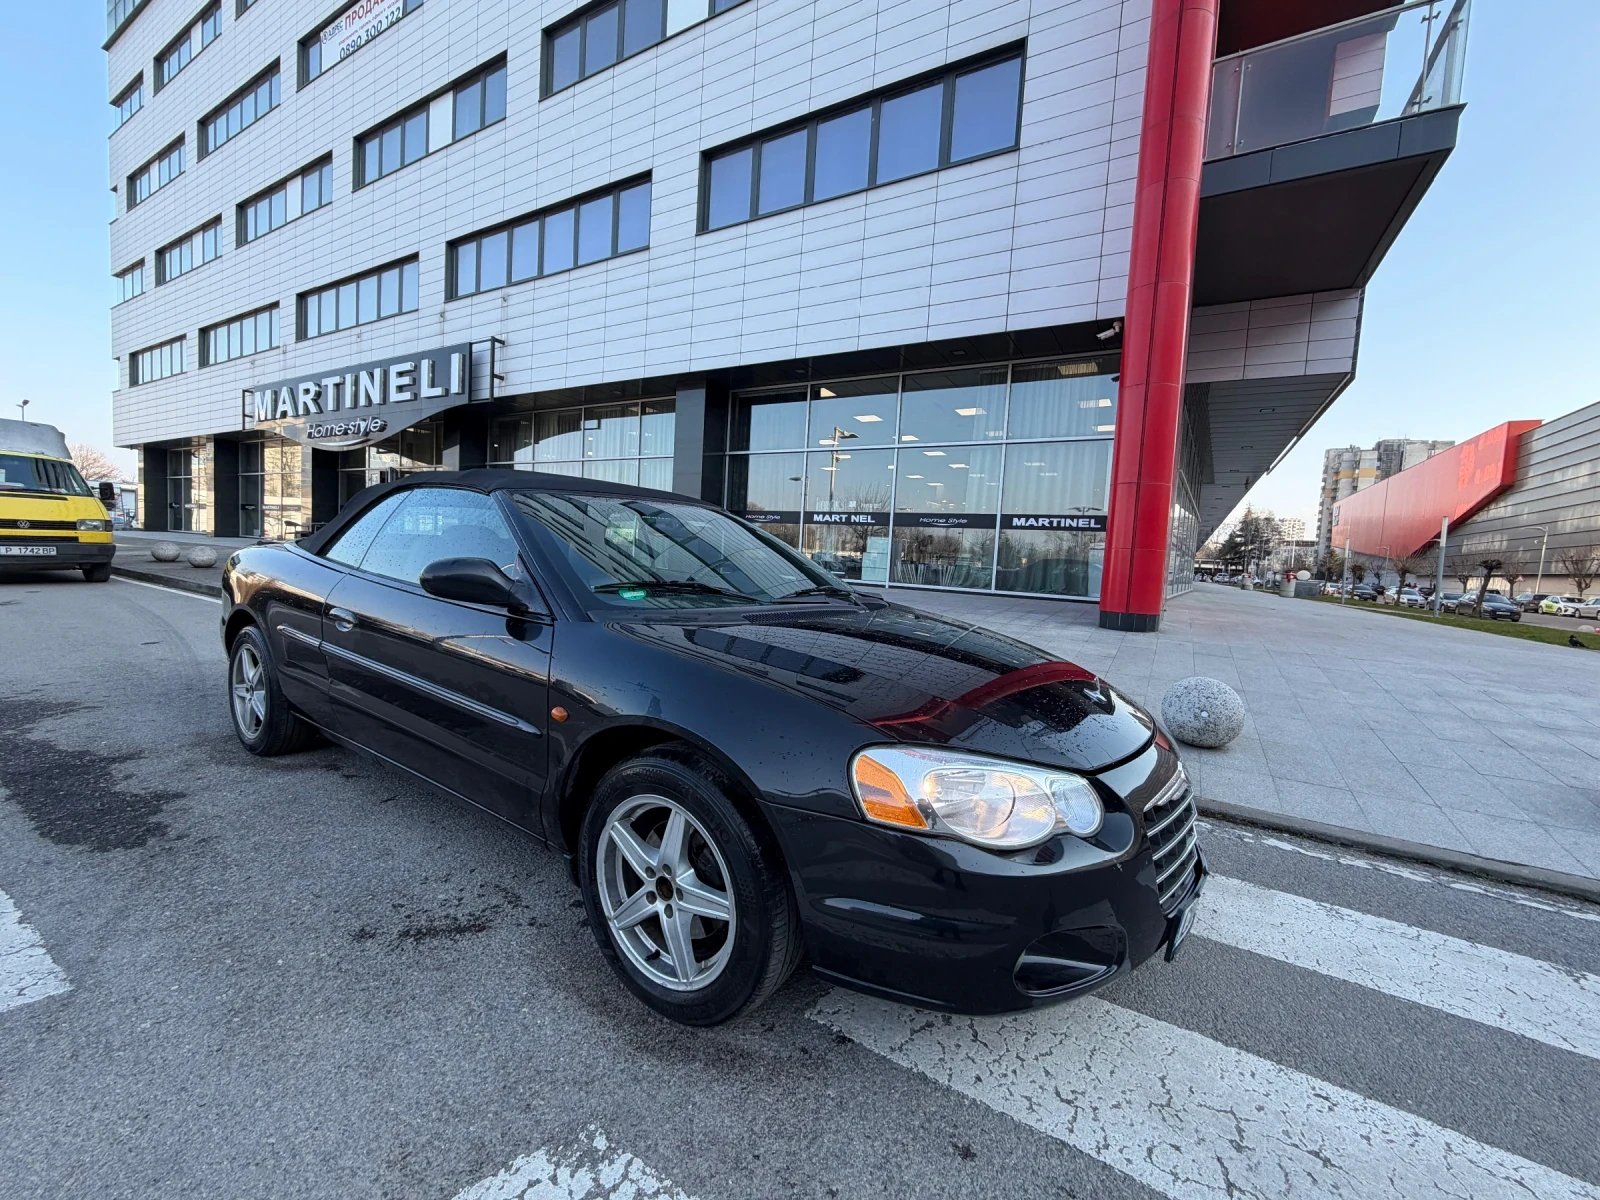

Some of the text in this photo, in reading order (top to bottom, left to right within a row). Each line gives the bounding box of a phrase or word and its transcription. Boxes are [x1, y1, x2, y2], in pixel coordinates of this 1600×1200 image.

[339, 35, 362, 60] 0890
[364, 20, 383, 43] 300
[385, 8, 401, 28] 122
[344, 0, 385, 31] ПРОДА
[254, 352, 467, 422] MARTINELI
[1012, 517, 1101, 528] MARTINEL
